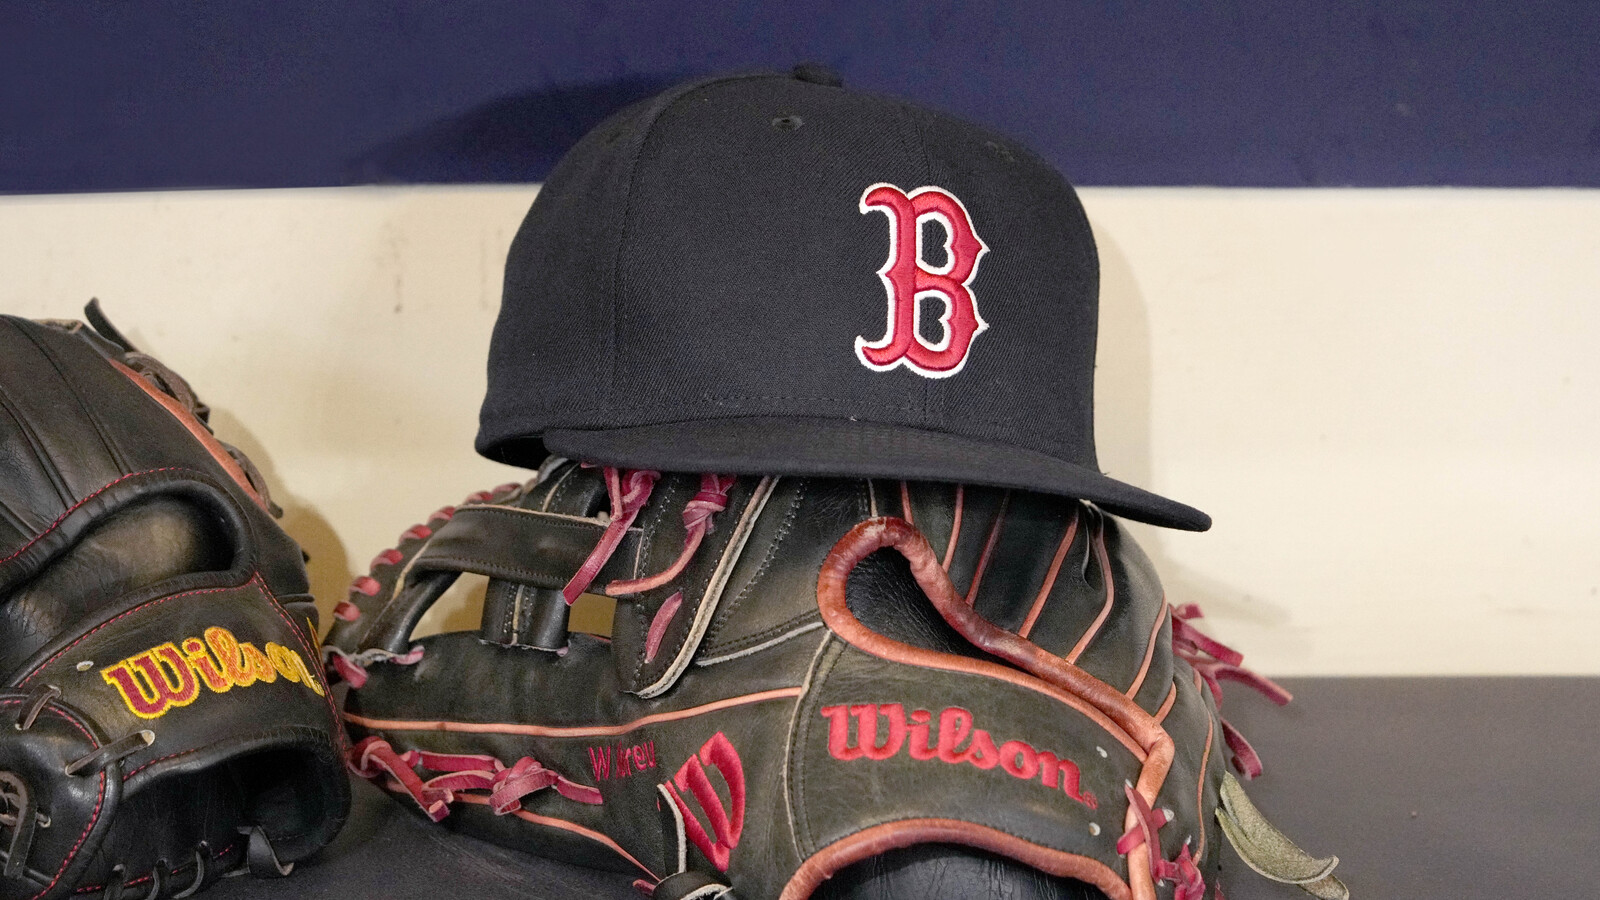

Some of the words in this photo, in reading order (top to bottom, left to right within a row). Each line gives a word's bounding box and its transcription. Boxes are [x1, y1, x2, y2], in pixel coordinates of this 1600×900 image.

[855, 182, 990, 379] B
[100, 626, 325, 719] Wilson
[820, 703, 1086, 804] Wilson
